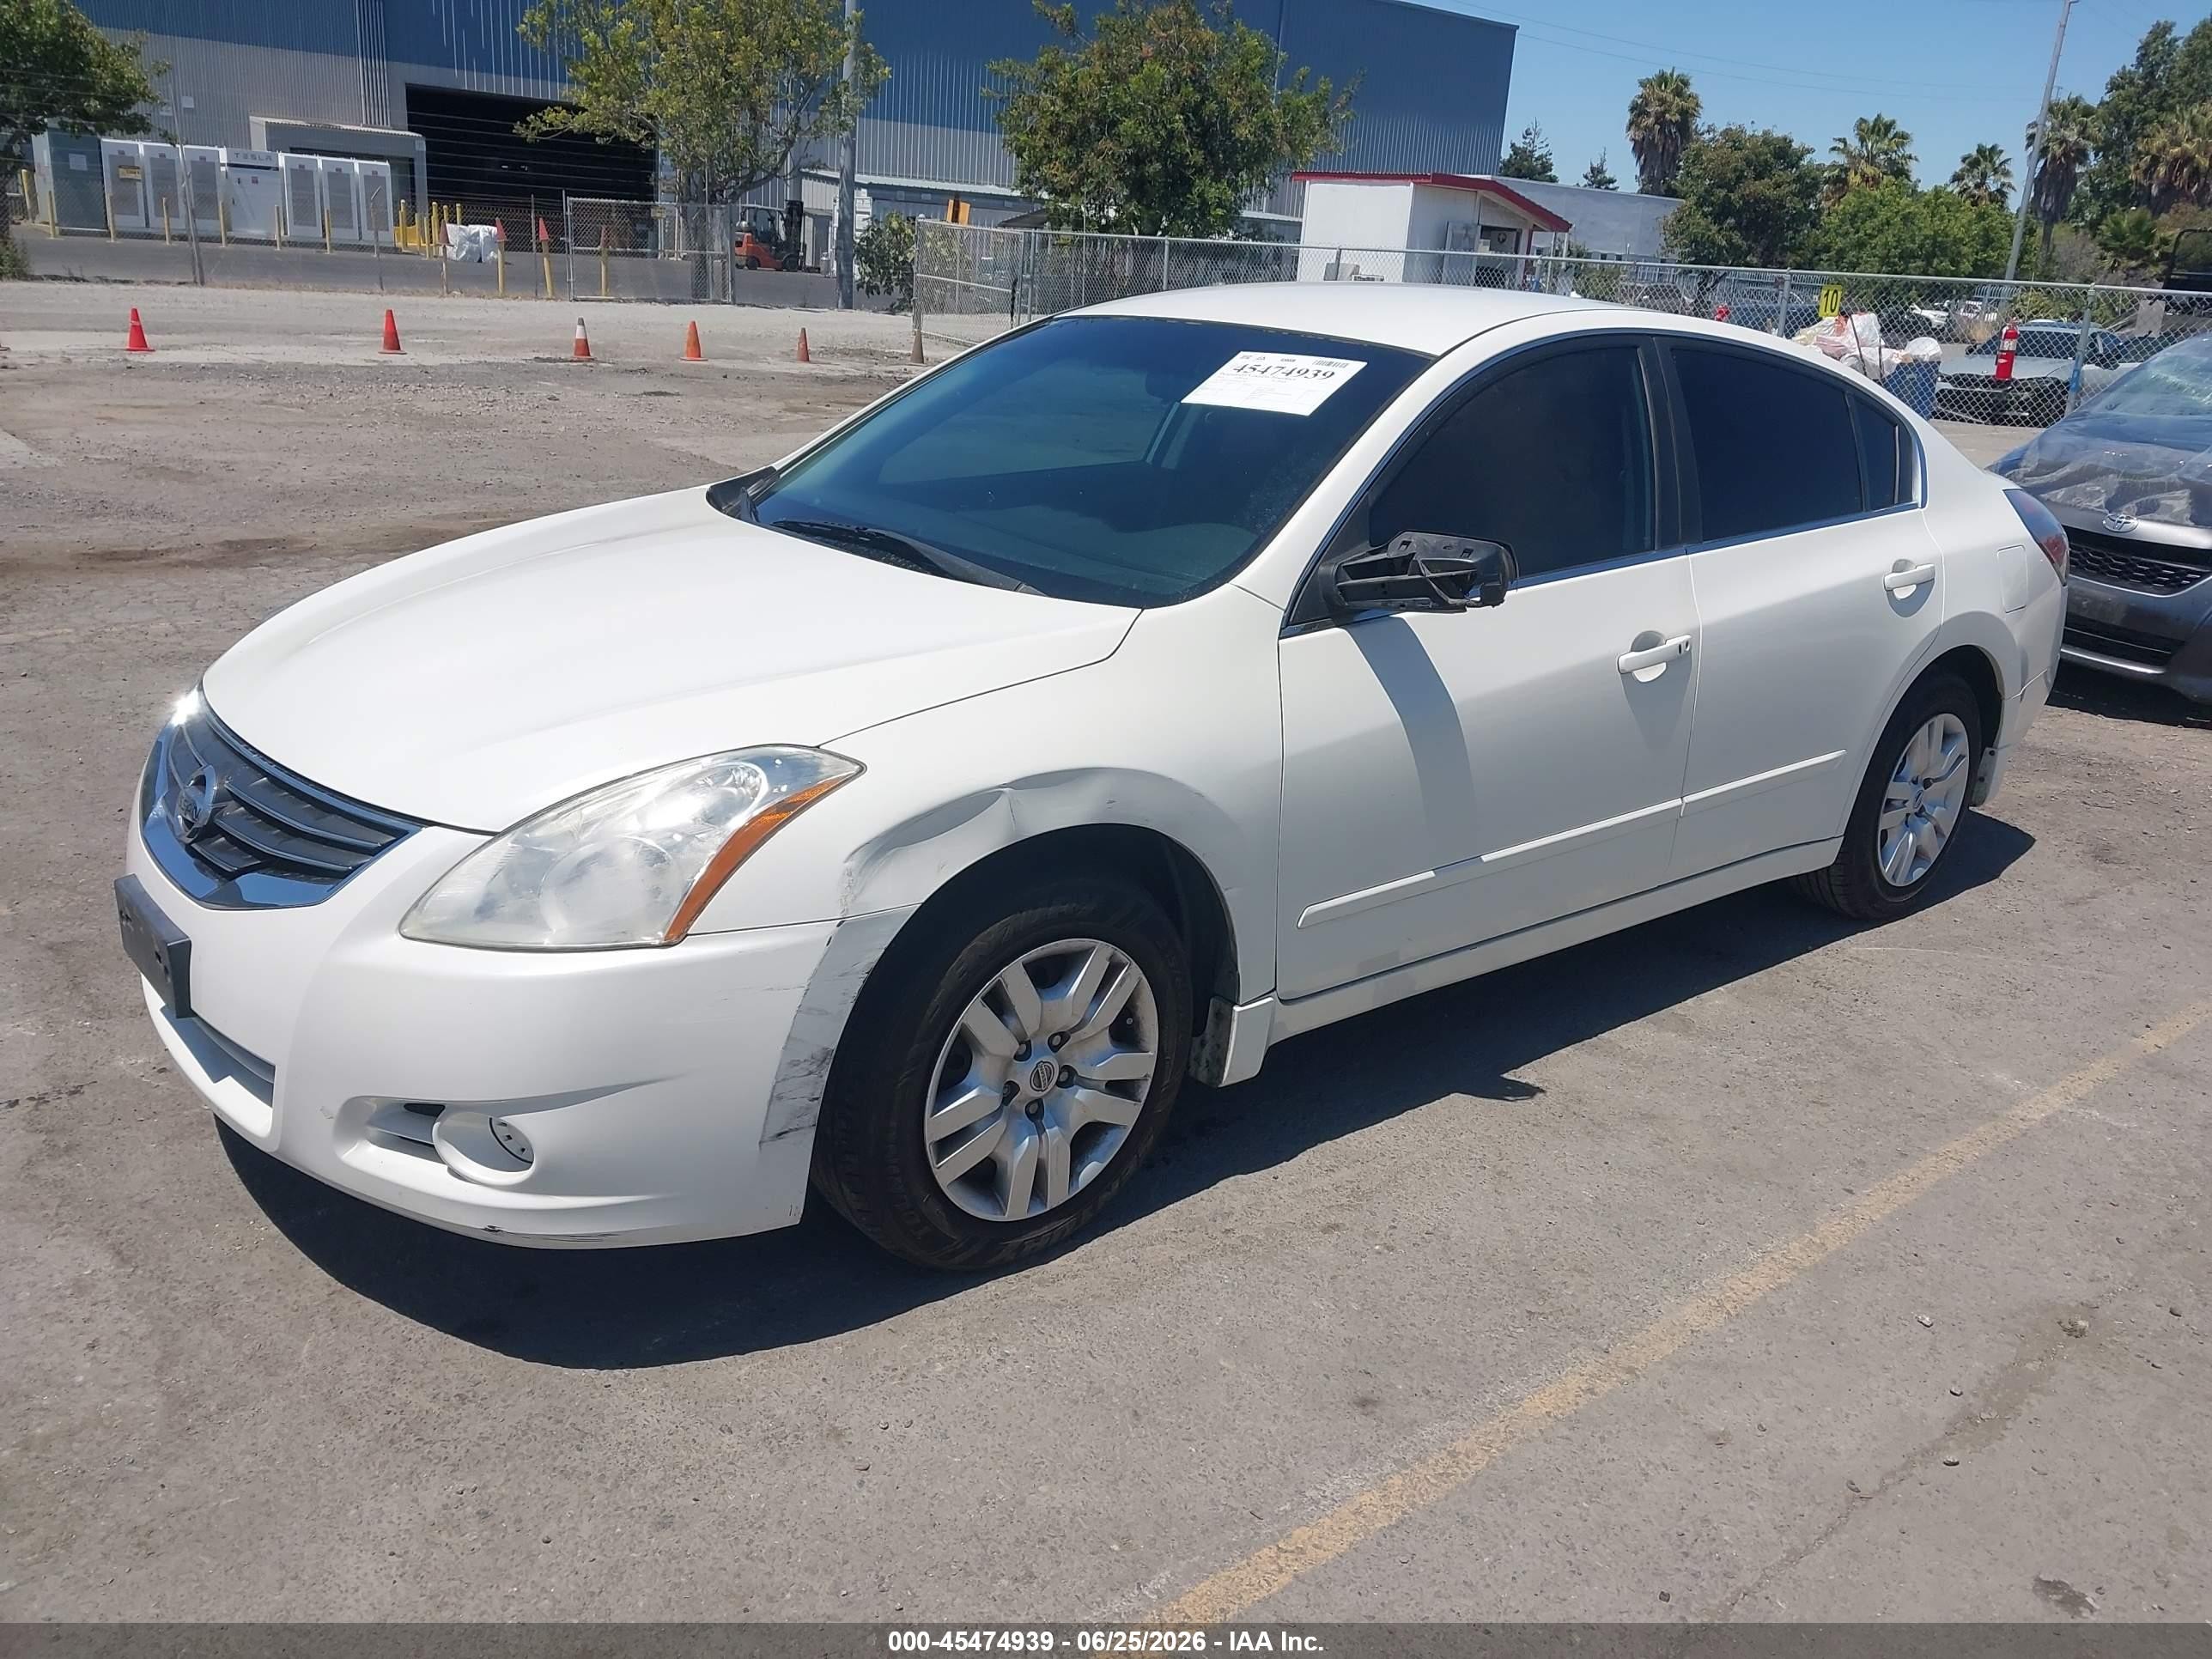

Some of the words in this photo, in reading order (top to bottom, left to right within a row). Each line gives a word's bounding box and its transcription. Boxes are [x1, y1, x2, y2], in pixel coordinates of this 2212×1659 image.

[234, 152, 272, 161] TESLA
[1823, 289, 1838, 313] 10
[1233, 363, 1335, 380] 45474939
